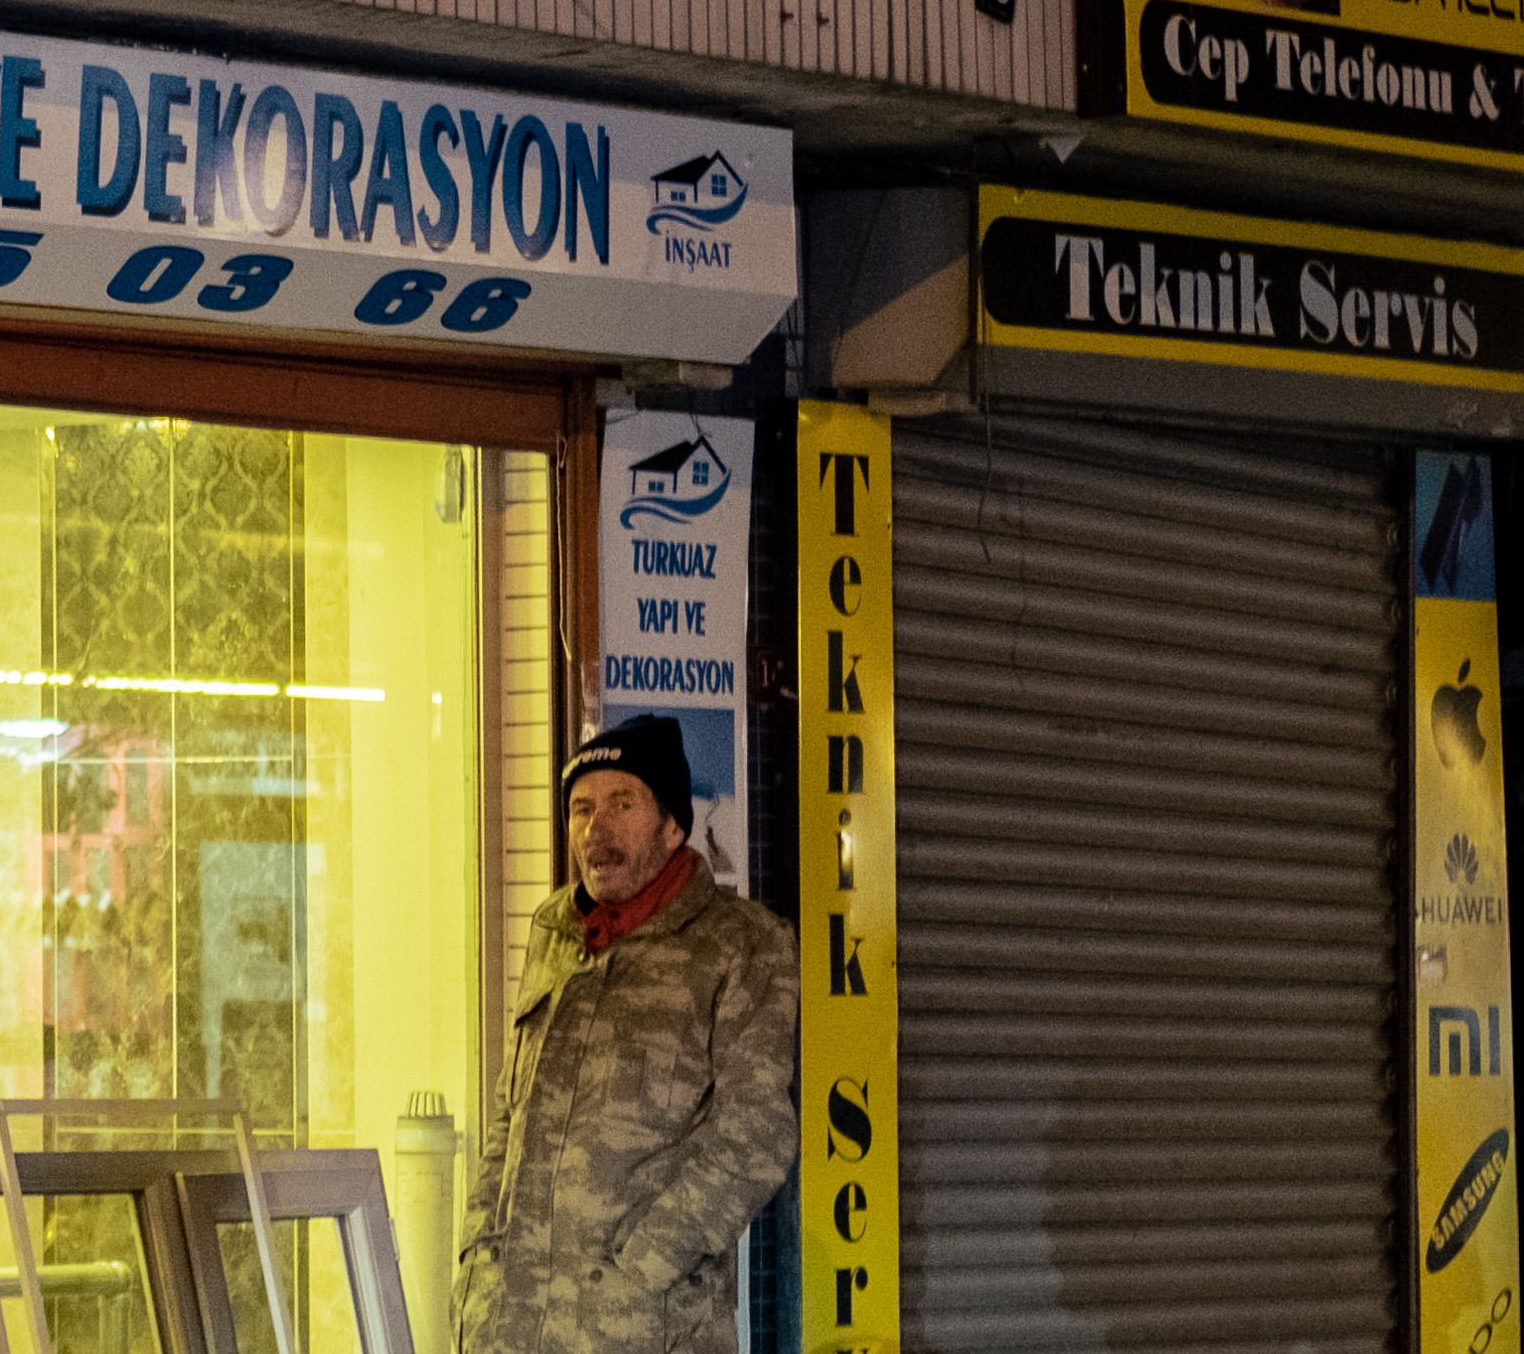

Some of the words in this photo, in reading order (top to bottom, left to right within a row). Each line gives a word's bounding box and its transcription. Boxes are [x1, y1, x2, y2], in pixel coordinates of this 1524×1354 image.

[1163, 13, 1252, 102] Cep
[1266, 28, 1453, 117] Telefonu
[1469, 65, 1500, 120] &
[77, 64, 611, 265] DEKORASYON
[106, 244, 296, 313] 03
[354, 269, 533, 333] 66
[664, 227, 732, 274] İNŞAAT
[1054, 233, 1276, 340] Teknik
[1298, 259, 1480, 362] Servis
[631, 539, 718, 580] TURKUAZ
[636, 597, 679, 635] YAPI
[685, 600, 707, 637] VE
[604, 653, 735, 696] DEKORASYON
[818, 453, 869, 998] Teknik
[1421, 896, 1504, 925] HUAWEI
[1430, 1153, 1504, 1251] SAMSUNG
